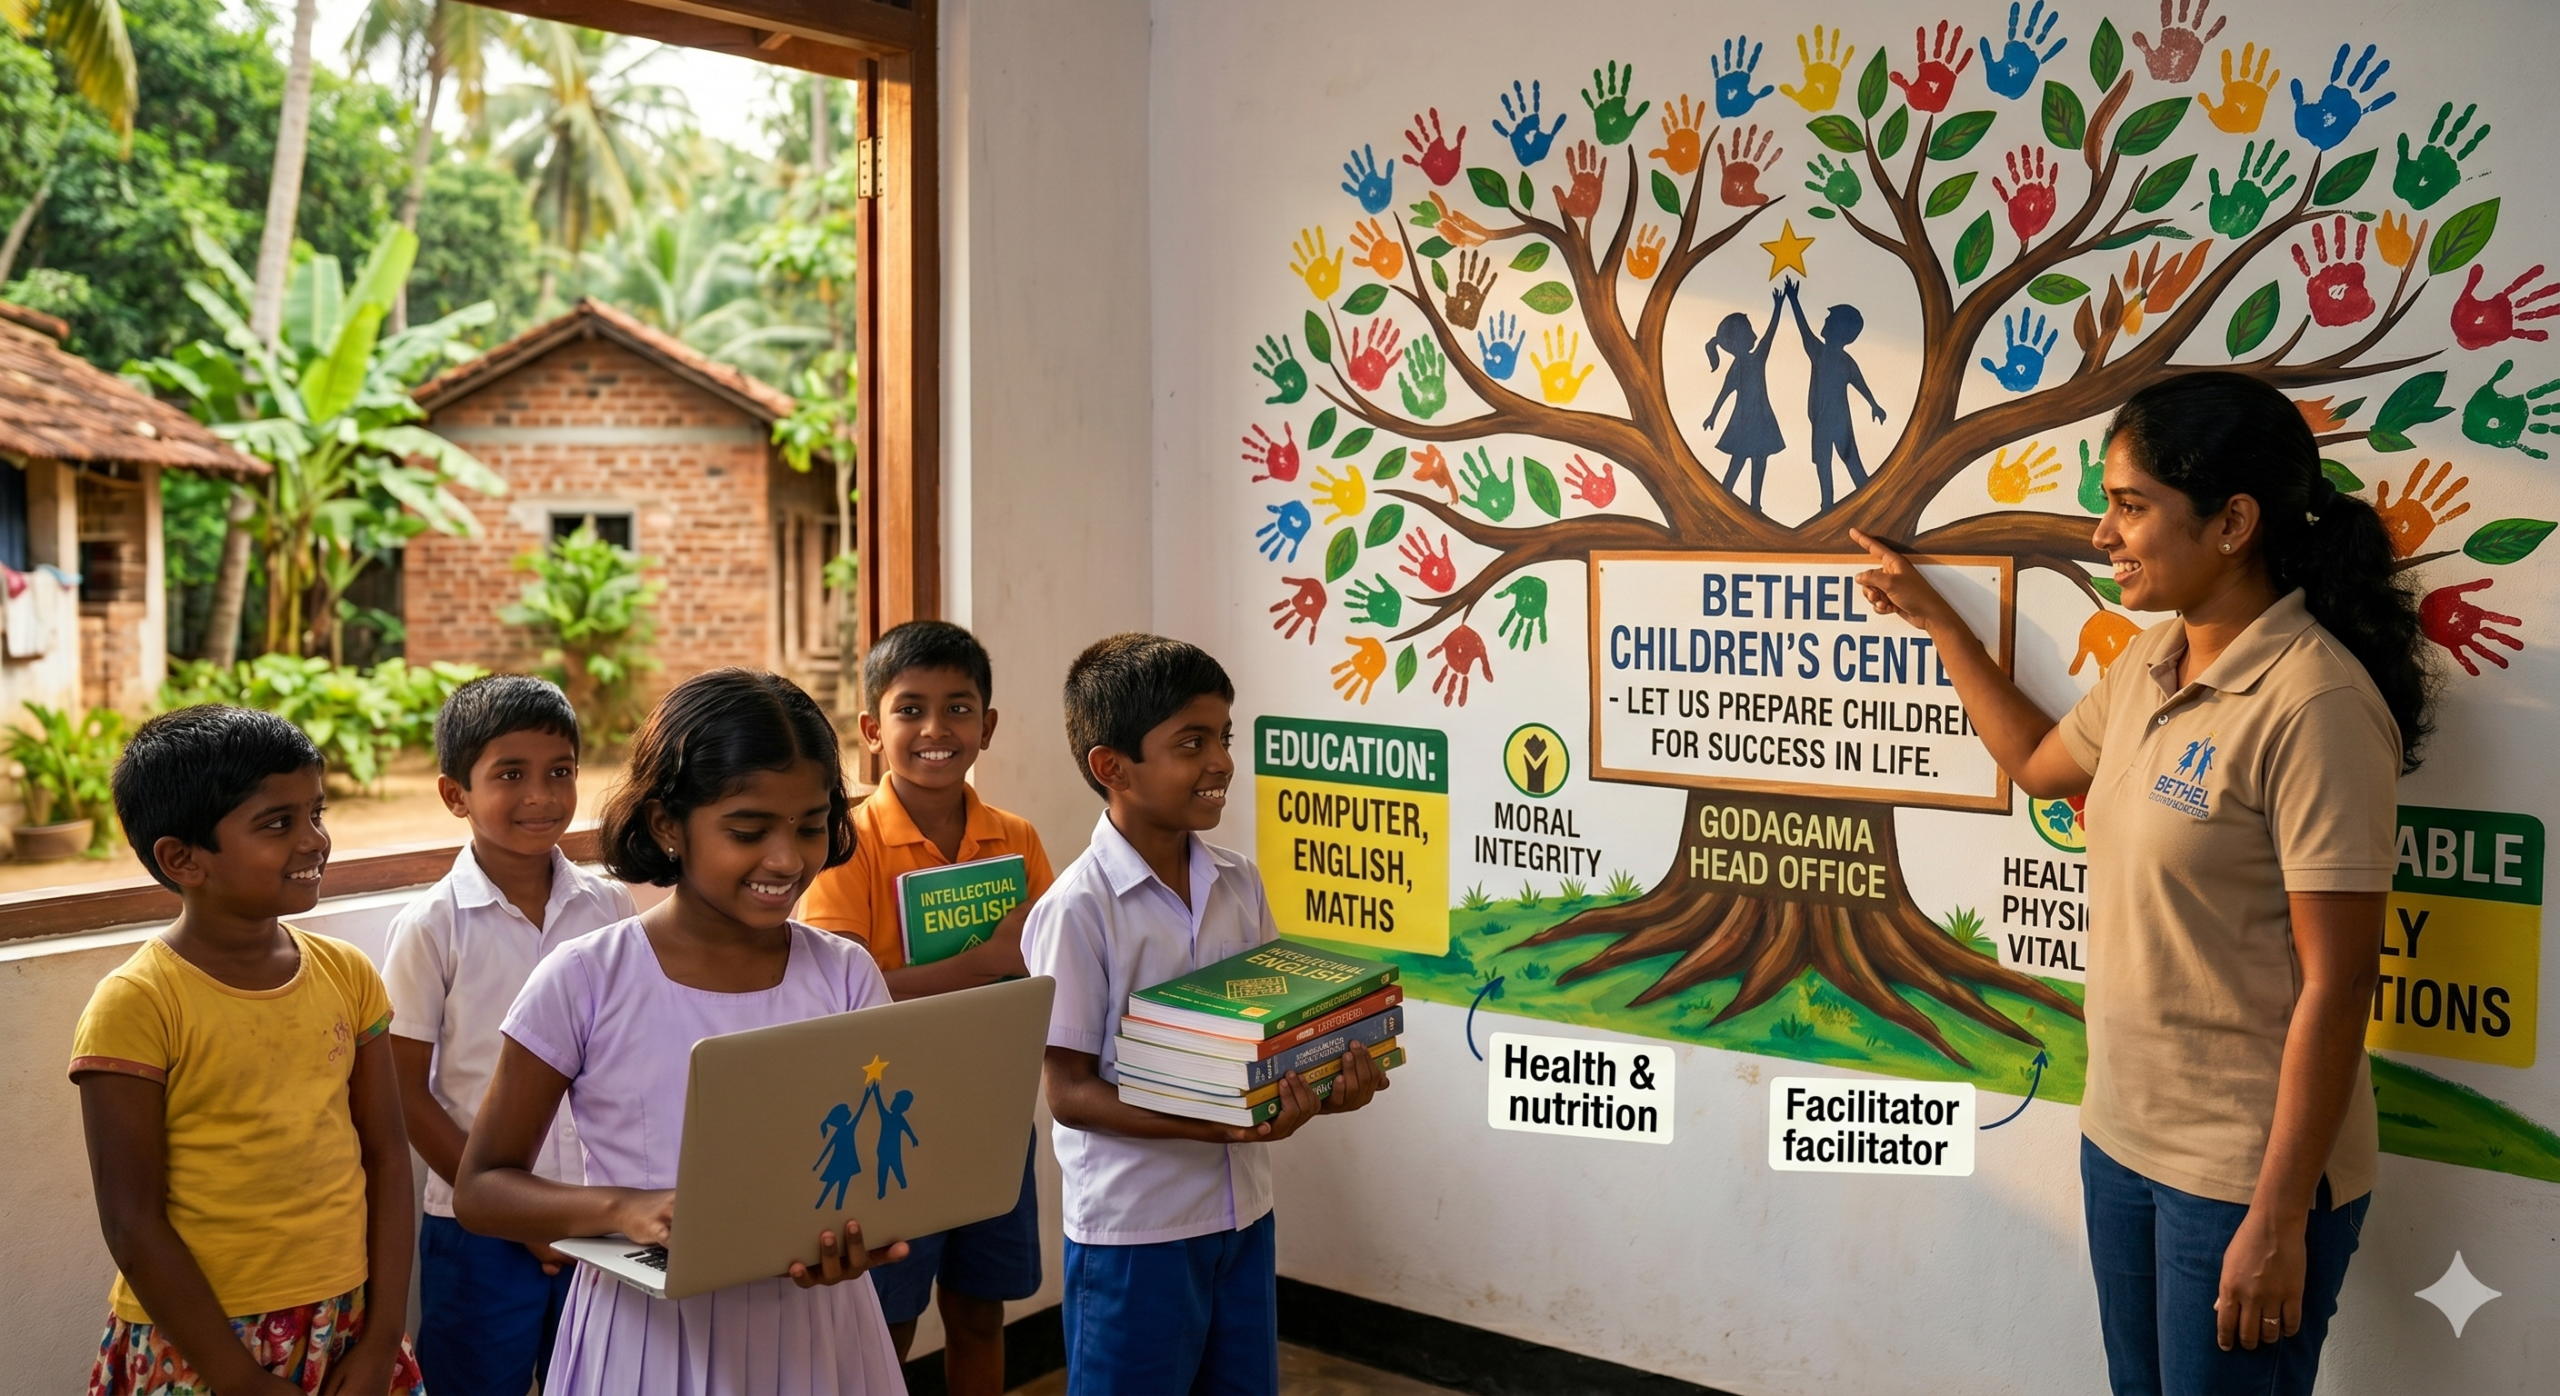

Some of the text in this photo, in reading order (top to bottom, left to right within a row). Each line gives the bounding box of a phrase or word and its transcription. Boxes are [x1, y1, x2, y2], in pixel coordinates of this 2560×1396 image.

[1702, 573, 1868, 623] BETHEL
[1610, 625, 1820, 680] CHILDREN'S
[1627, 686, 1670, 717] LET
[1678, 689, 1710, 719] US
[1718, 691, 1833, 727] PREPARE
[1265, 728, 1437, 782] EDUCATION:
[1651, 728, 1940, 778] FOR SUCCESS IN LIFE.
[2154, 774, 2210, 809] BETHEL
[1278, 789, 1429, 846] COMPUTER,
[1494, 801, 1581, 839] MORAL
[1700, 804, 1876, 854] GODAGAMA
[1293, 837, 1413, 894] ENGLISH,
[1474, 835, 1602, 878] INTEGRITY
[1689, 846, 1886, 899] HEAD OFFICE
[920, 877, 1017, 907] INTELLECTUAL
[1305, 888, 1395, 933] MATHS
[2002, 894, 2090, 932] PHYSI
[923, 896, 1016, 934] ENGLISH
[1245, 953, 1354, 984] ENGLISH
[1504, 1043, 1656, 1091] Health &
[1508, 1092, 1658, 1133] nutrition
[1785, 1087, 1960, 1126] Facilitator
[1783, 1128, 1949, 1166] facilitator
